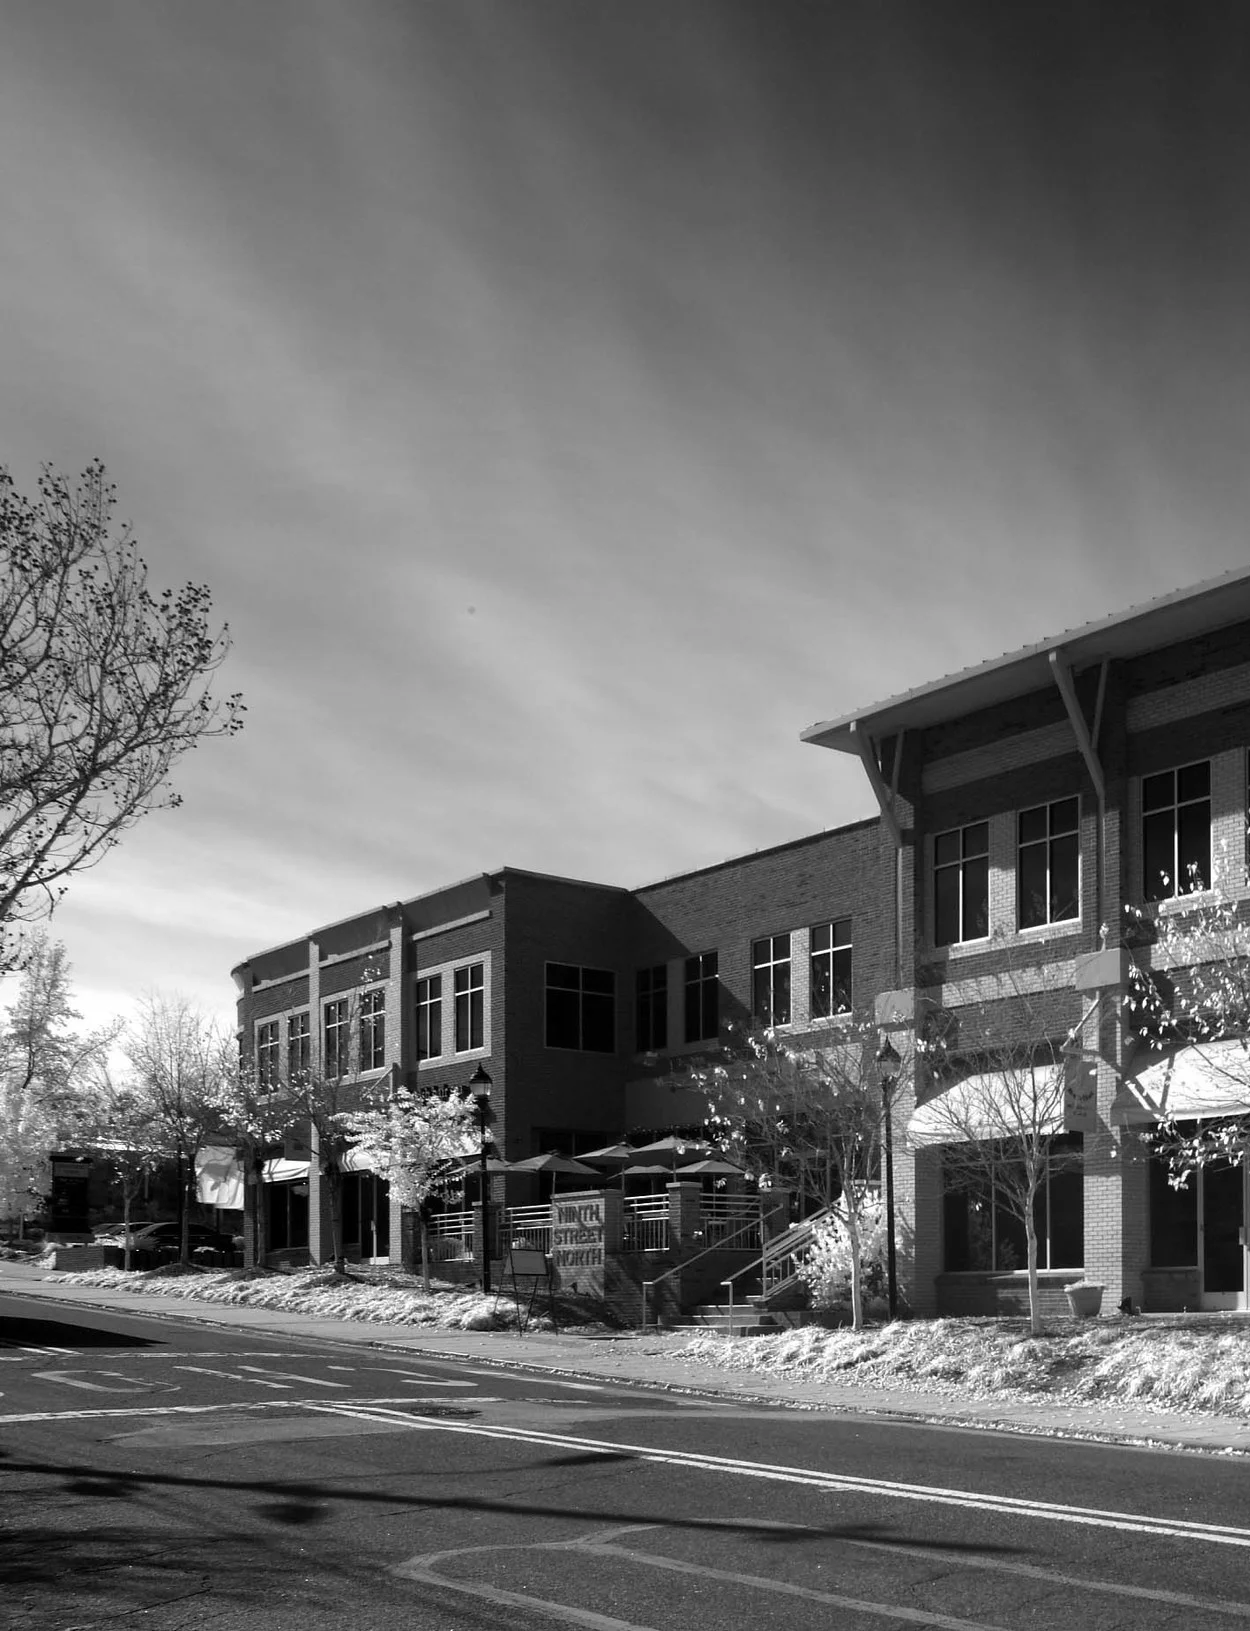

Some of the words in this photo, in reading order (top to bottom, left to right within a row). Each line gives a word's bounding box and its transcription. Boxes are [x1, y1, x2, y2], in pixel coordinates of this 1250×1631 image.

[558, 1204, 600, 1224] NINTH
[554, 1227, 603, 1245] STREET
[556, 1248, 602, 1267] NORTH
